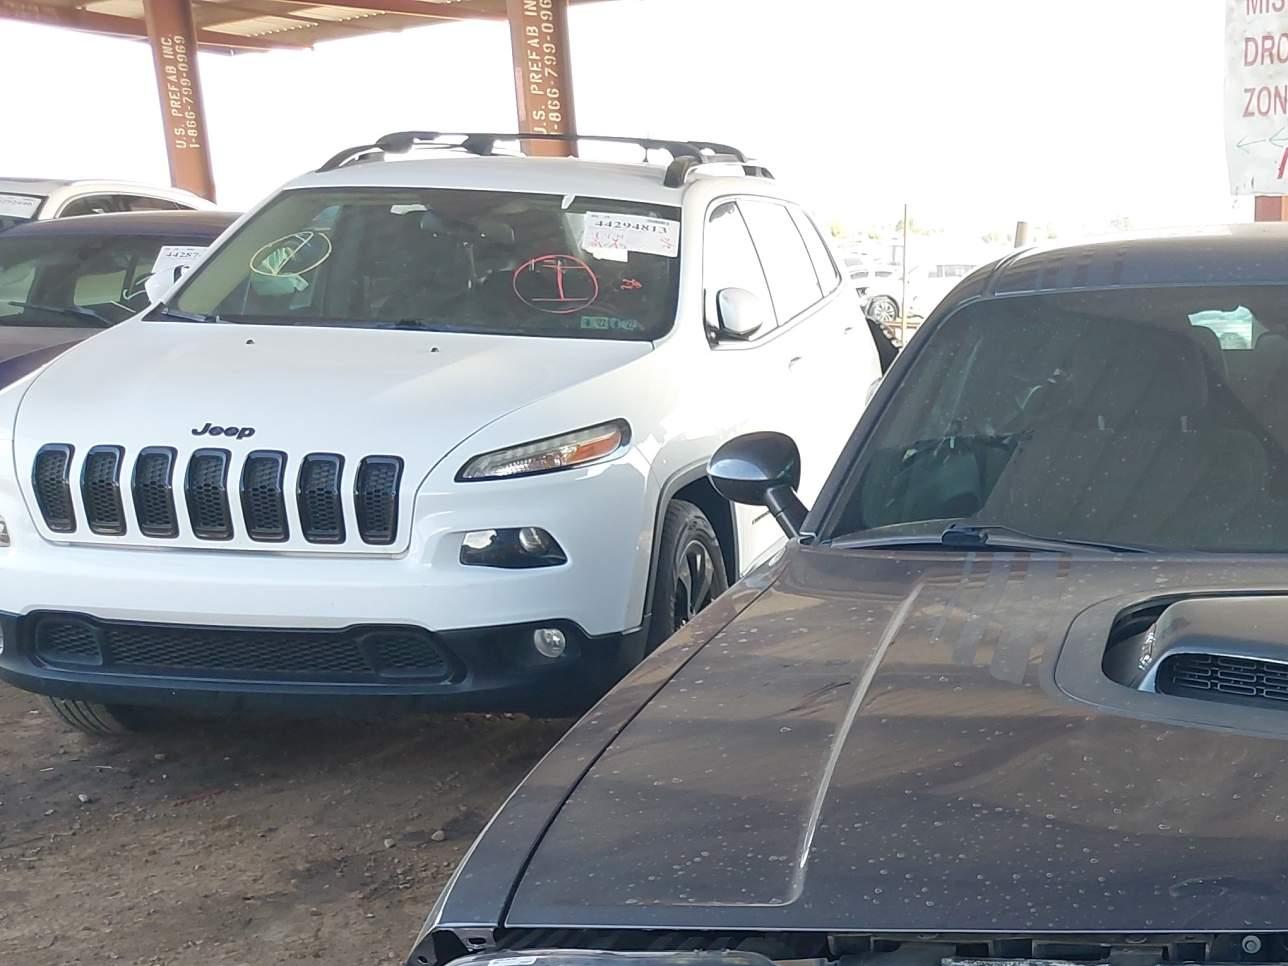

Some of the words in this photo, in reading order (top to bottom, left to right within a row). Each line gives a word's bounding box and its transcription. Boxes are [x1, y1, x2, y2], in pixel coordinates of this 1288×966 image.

[161, 33, 175, 59] INC.
[525, 25, 545, 95] PREFAB
[164, 65, 183, 117] PREFAB
[174, 124, 188, 149] U.S.
[191, 422, 256, 440] Jeep
